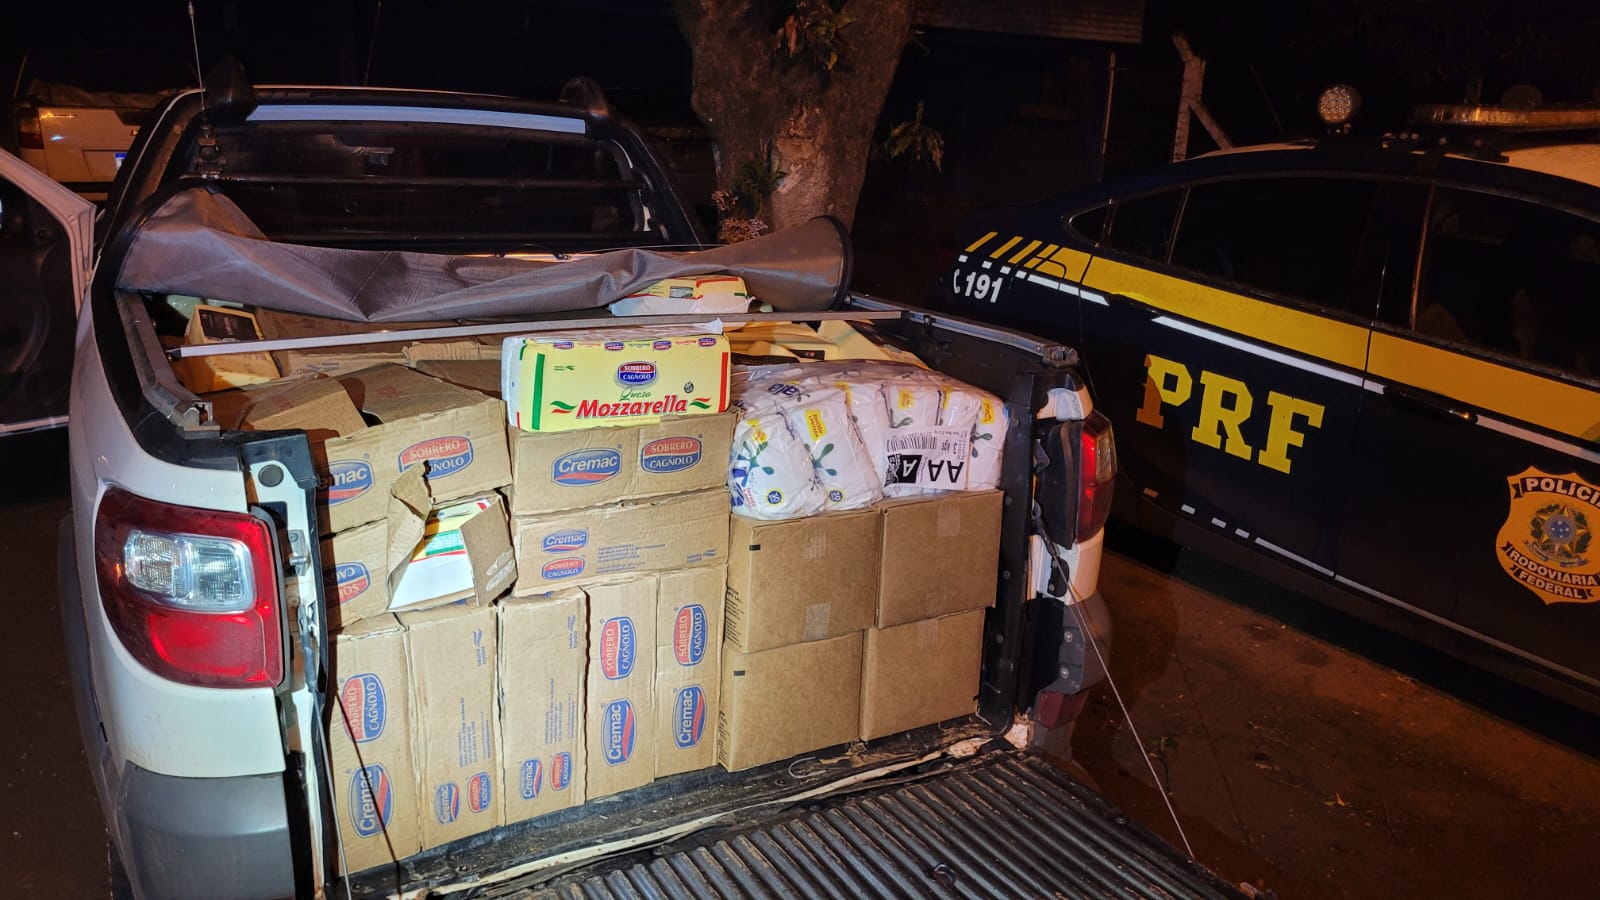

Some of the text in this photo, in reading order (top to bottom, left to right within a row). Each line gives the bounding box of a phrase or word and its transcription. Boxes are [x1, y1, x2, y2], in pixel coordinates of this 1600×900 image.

[964, 271, 1004, 303] 191
[576, 395, 687, 418] Mozzarella
[619, 385, 652, 401] Queso
[1135, 353, 1326, 475] PRF
[409, 440, 460, 460] SOBRERO
[558, 456, 618, 473] Cremac
[649, 455, 694, 469] CAGNOLO
[651, 440, 694, 453] SOBRERO
[546, 532, 586, 546] Cremac
[547, 568, 579, 578] CAGNOLO
[1519, 570, 1583, 598] FEDERAL
[605, 628, 615, 671] SOBRERO
[621, 624, 630, 670] CAGNOLO
[679, 615, 688, 657] SOBRERO
[694, 612, 702, 656] CAGNOLO
[347, 686, 360, 733] SOBRERO
[366, 681, 380, 731] CAGNOLO
[680, 689, 693, 744] Cremac
[608, 703, 621, 760] Cremac
[523, 761, 534, 797] Cremac
[359, 768, 376, 831] Cremac
[439, 785, 451, 823] Cremac
